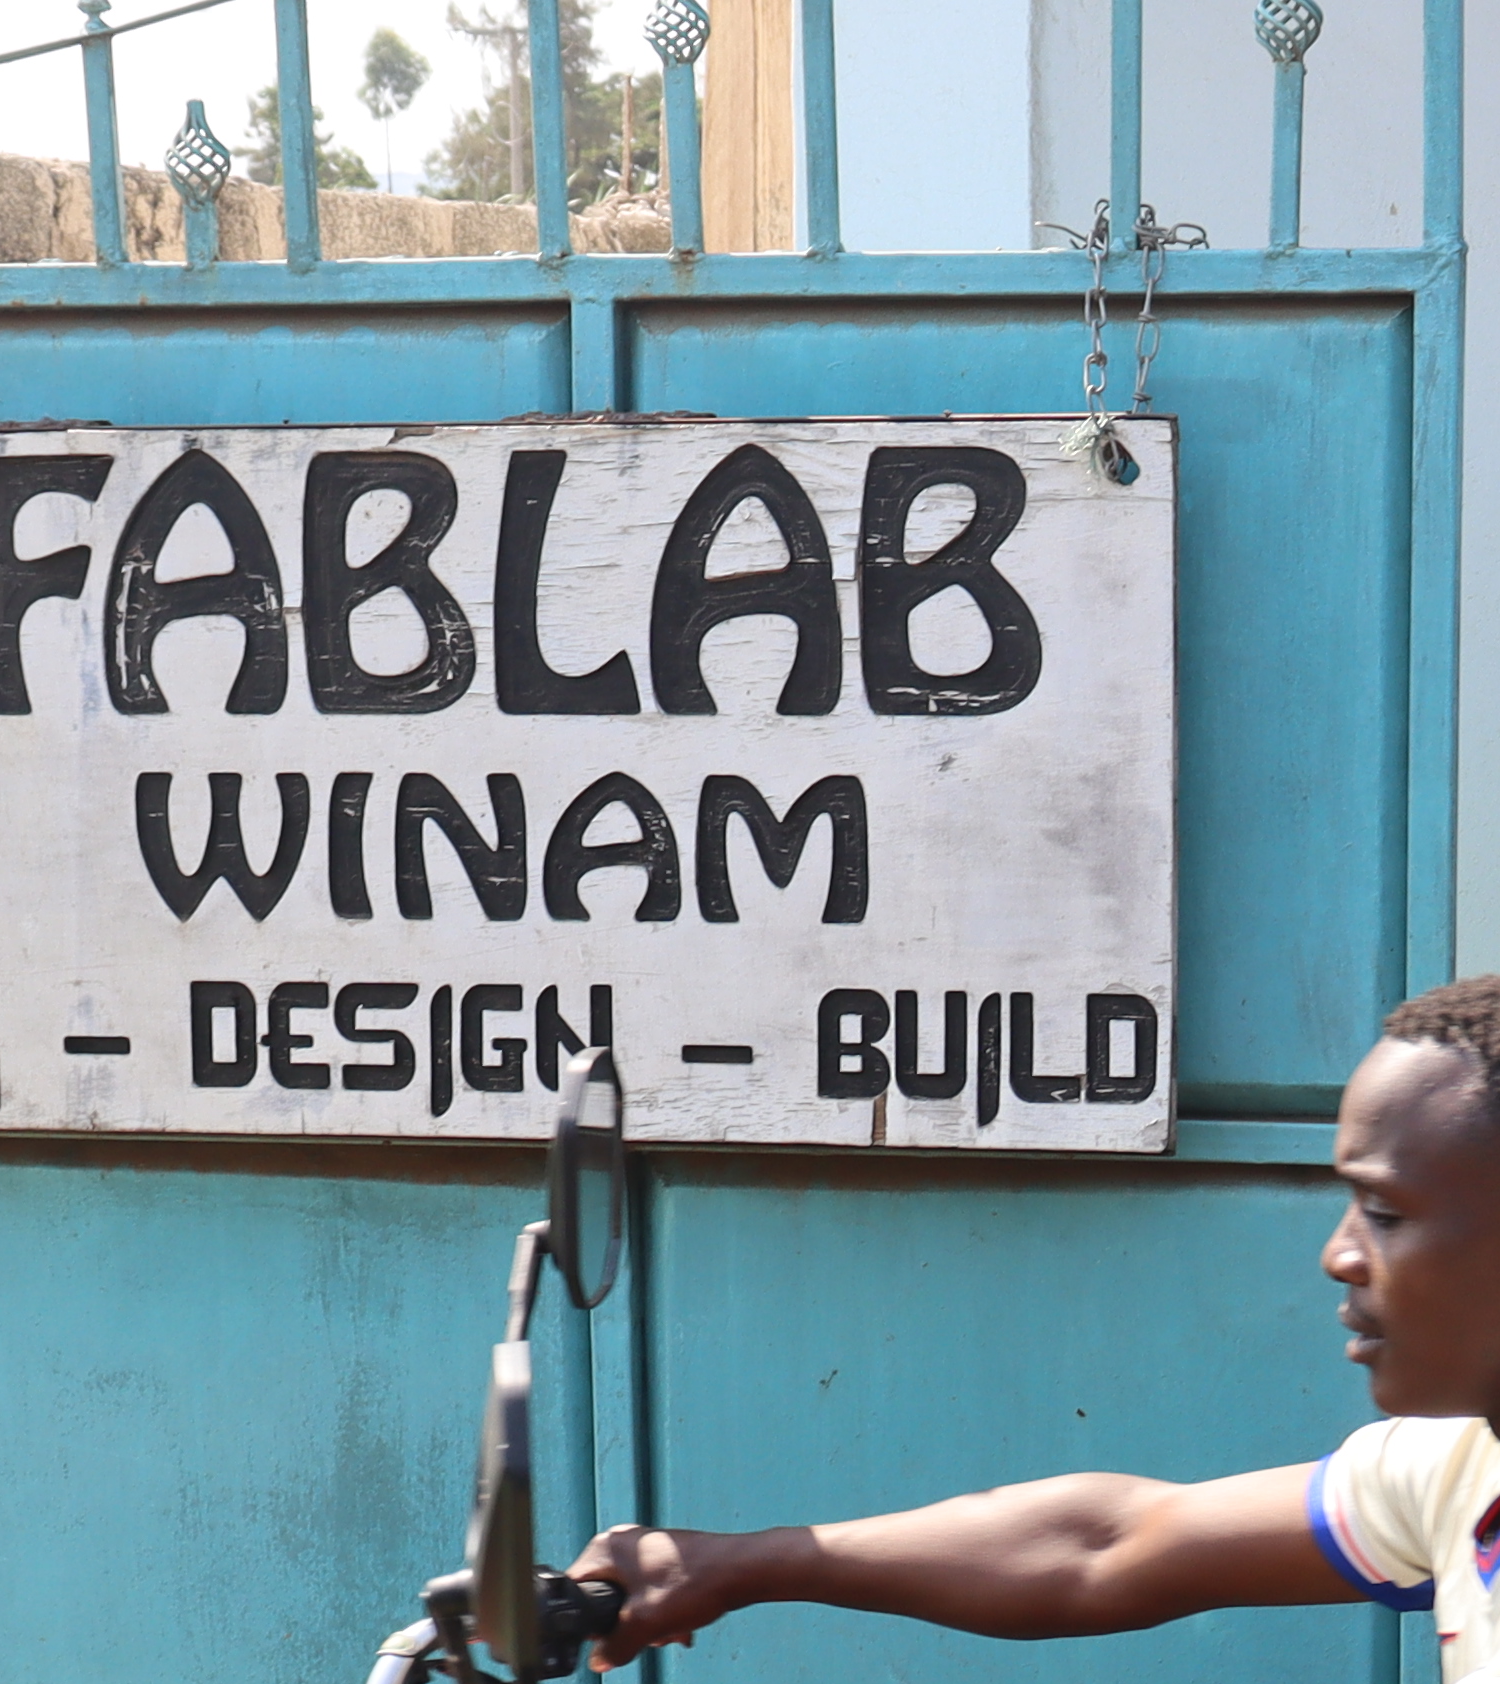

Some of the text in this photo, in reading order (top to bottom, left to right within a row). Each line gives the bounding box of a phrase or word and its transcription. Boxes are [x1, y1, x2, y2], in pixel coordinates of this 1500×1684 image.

[134, 771, 868, 925] WINAM
[190, 980, 613, 1118] DESIGN
[817, 988, 1159, 1127] BUILD
